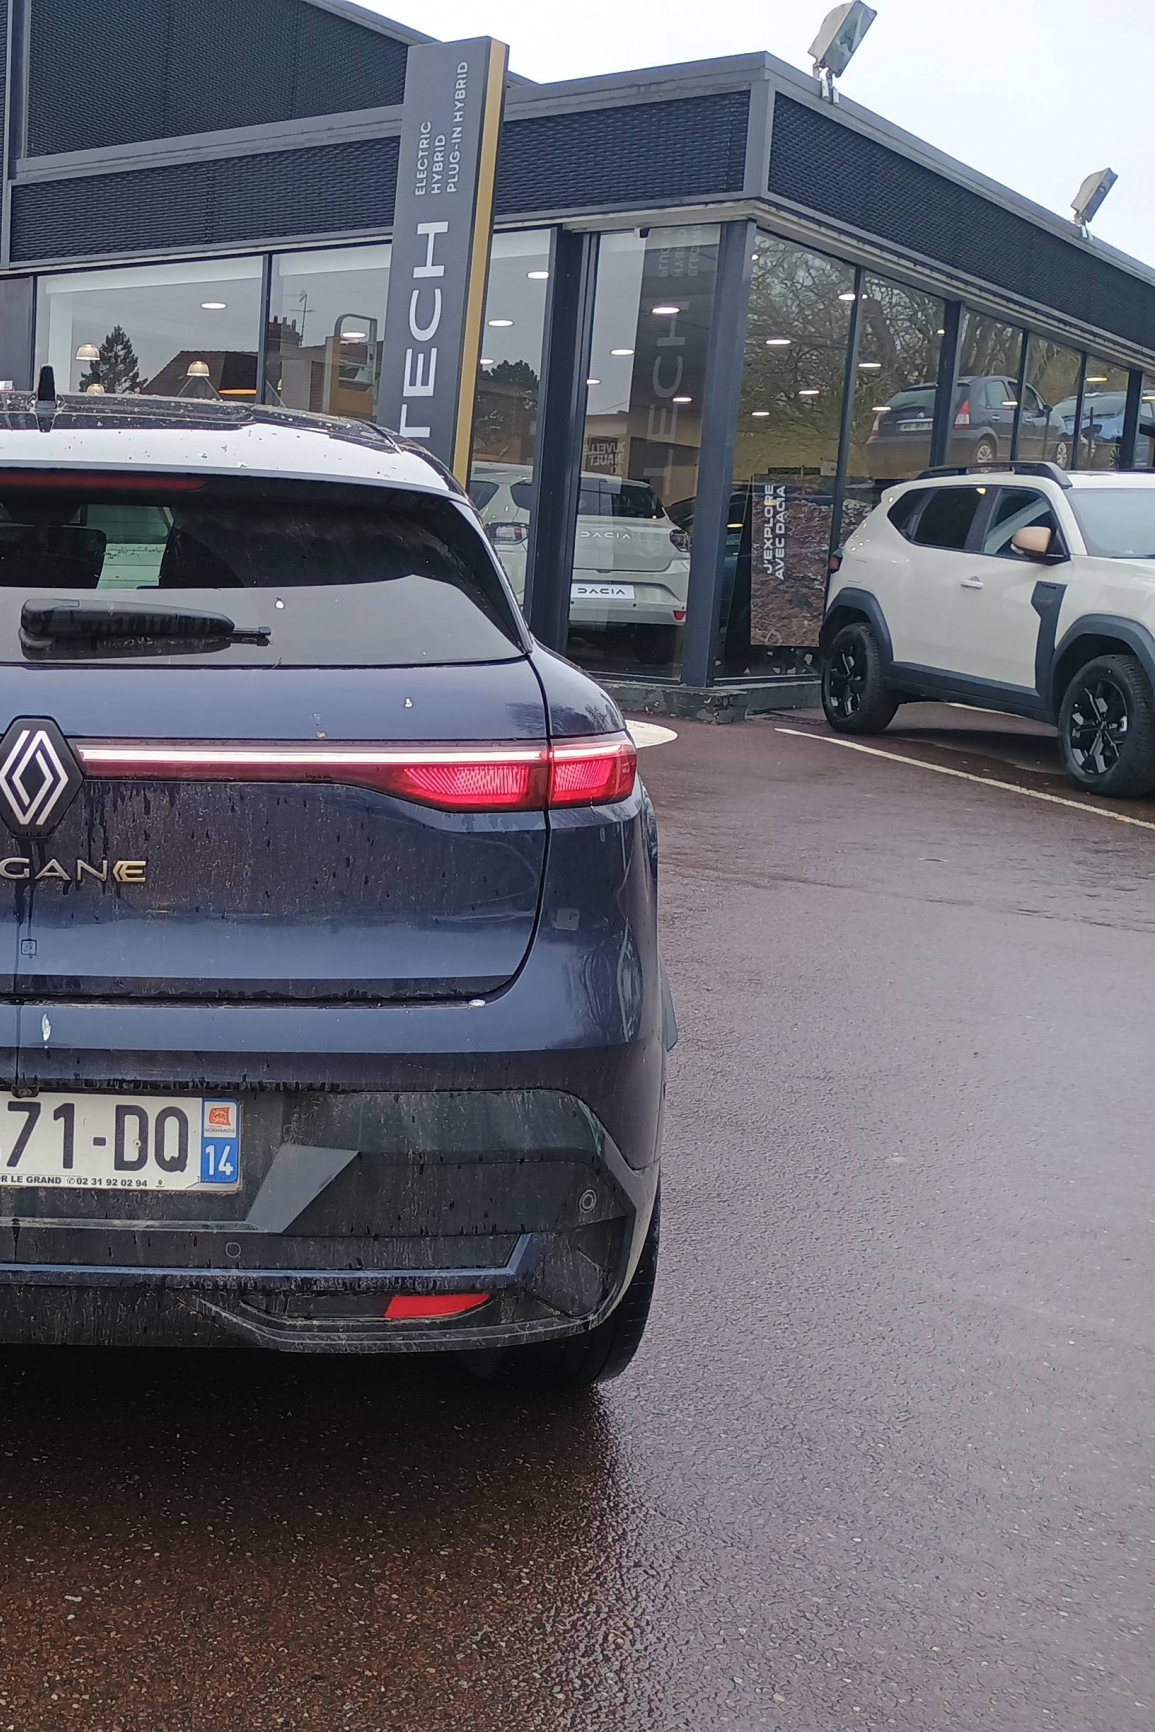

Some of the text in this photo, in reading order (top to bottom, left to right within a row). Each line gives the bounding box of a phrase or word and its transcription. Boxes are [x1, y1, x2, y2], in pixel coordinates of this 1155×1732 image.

[446, 61, 468, 193] PLUG-IN HYBRID
[415, 121, 431, 195] ELECTRIC
[431, 134, 446, 194] HYBRID
[579, 531, 632, 539] DACIA
[763, 484, 774, 574] J'EXPLORE
[775, 485, 786, 580] AVEC DACIA
[577, 587, 626, 595] DACIA
[11, 1175, 23, 1183] LE
[26, 1175, 62, 1184] GRAND
[76, 1177, 88, 1186] 02
[91, 1178, 103, 1186] 31
[106, 1178, 118, 1186] 92
[120, 1178, 133, 1187] 02
[135, 1179, 148, 1187] 94
[205, 1145, 234, 1175] 14
